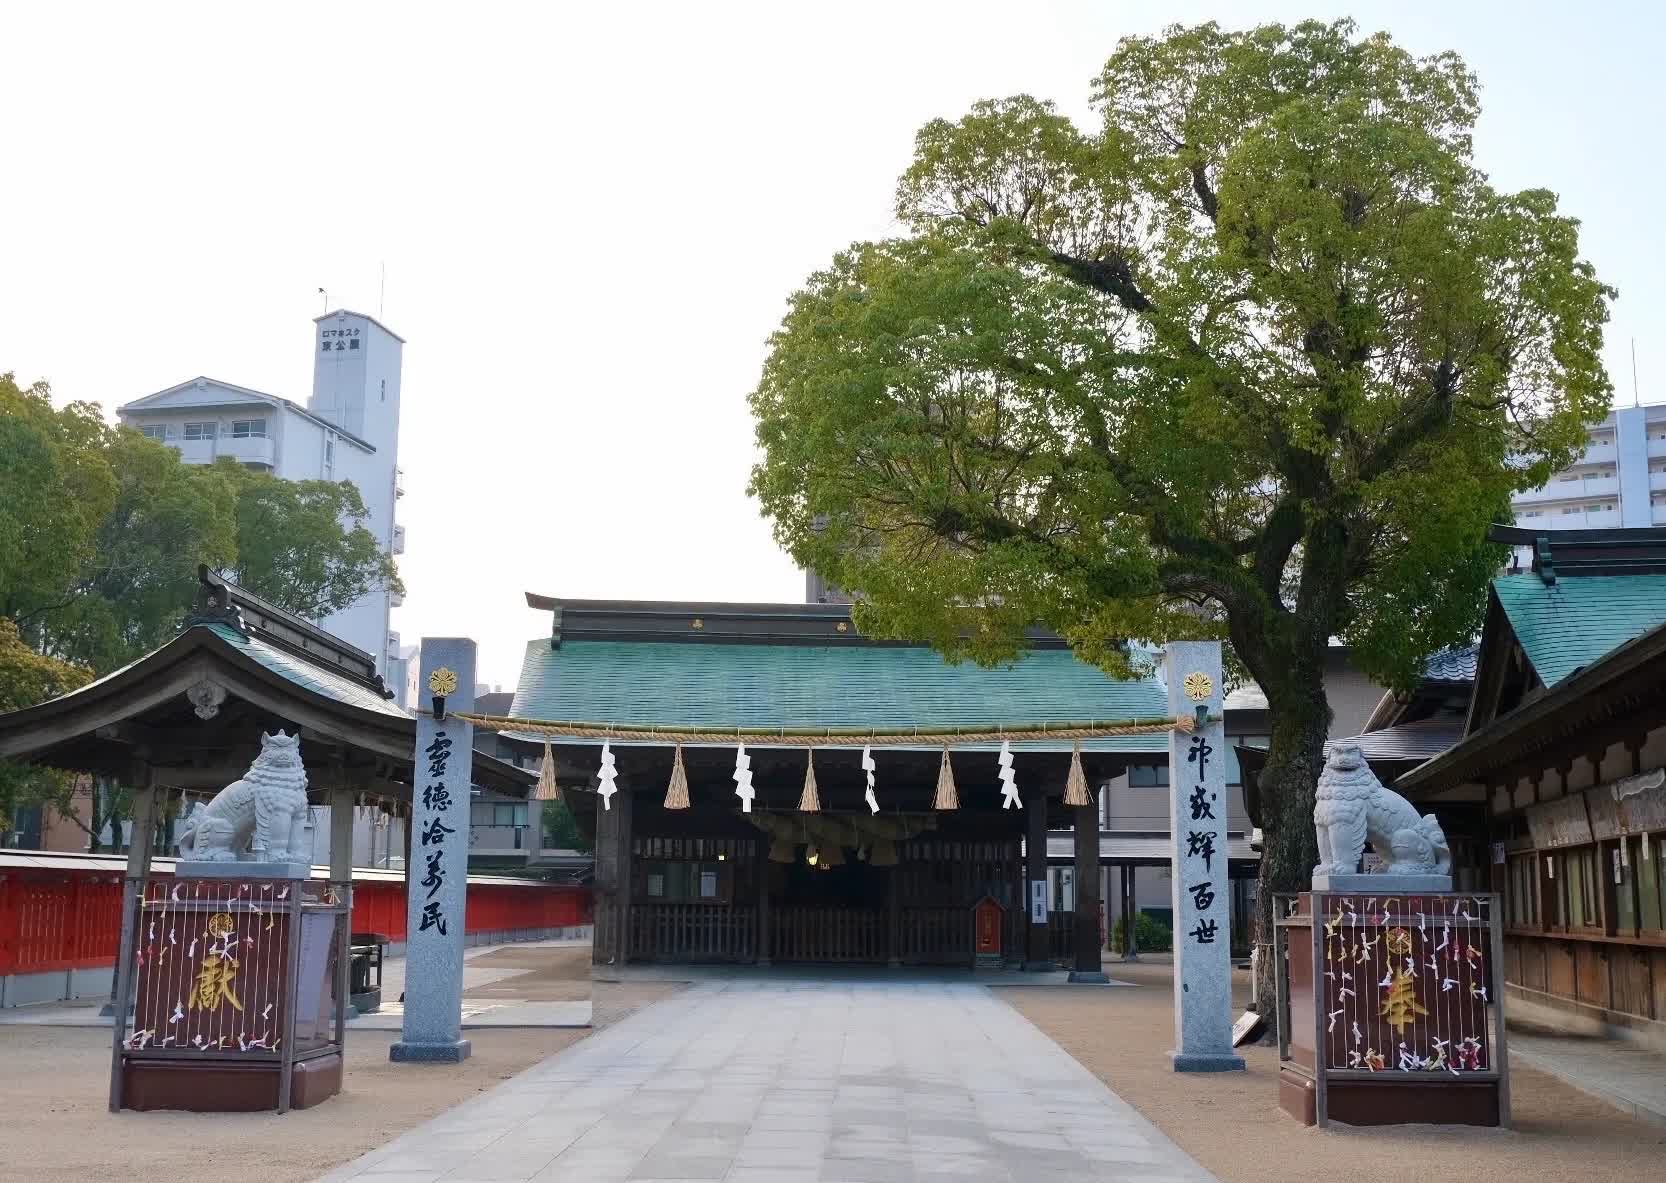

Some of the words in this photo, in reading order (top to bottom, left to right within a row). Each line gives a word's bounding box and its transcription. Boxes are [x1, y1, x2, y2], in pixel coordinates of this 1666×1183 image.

[322, 328, 360, 338] ロマネスク
[1377, 966, 1430, 1035] 奉
